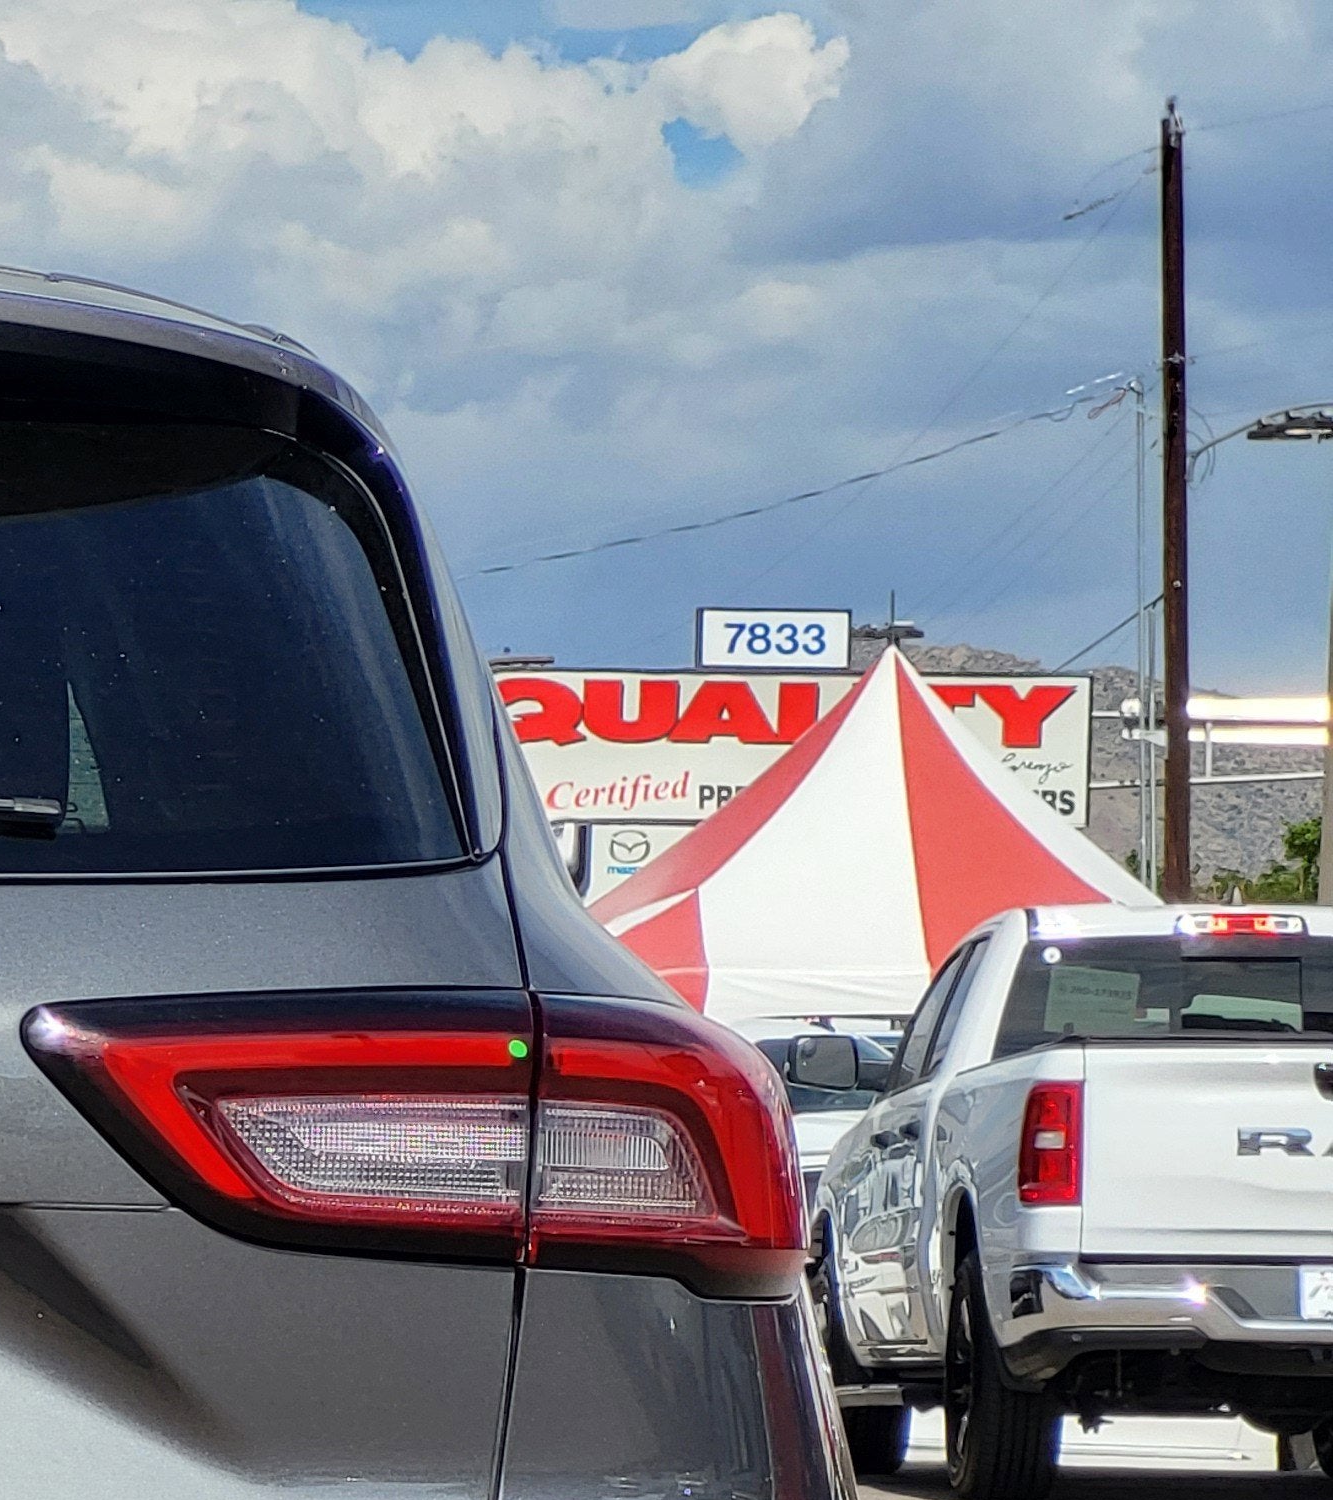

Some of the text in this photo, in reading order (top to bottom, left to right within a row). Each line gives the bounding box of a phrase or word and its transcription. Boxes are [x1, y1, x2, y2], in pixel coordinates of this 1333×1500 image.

[724, 622, 826, 655] 7833
[496, 678, 1079, 749] QUALY
[546, 771, 690, 812] Certified
